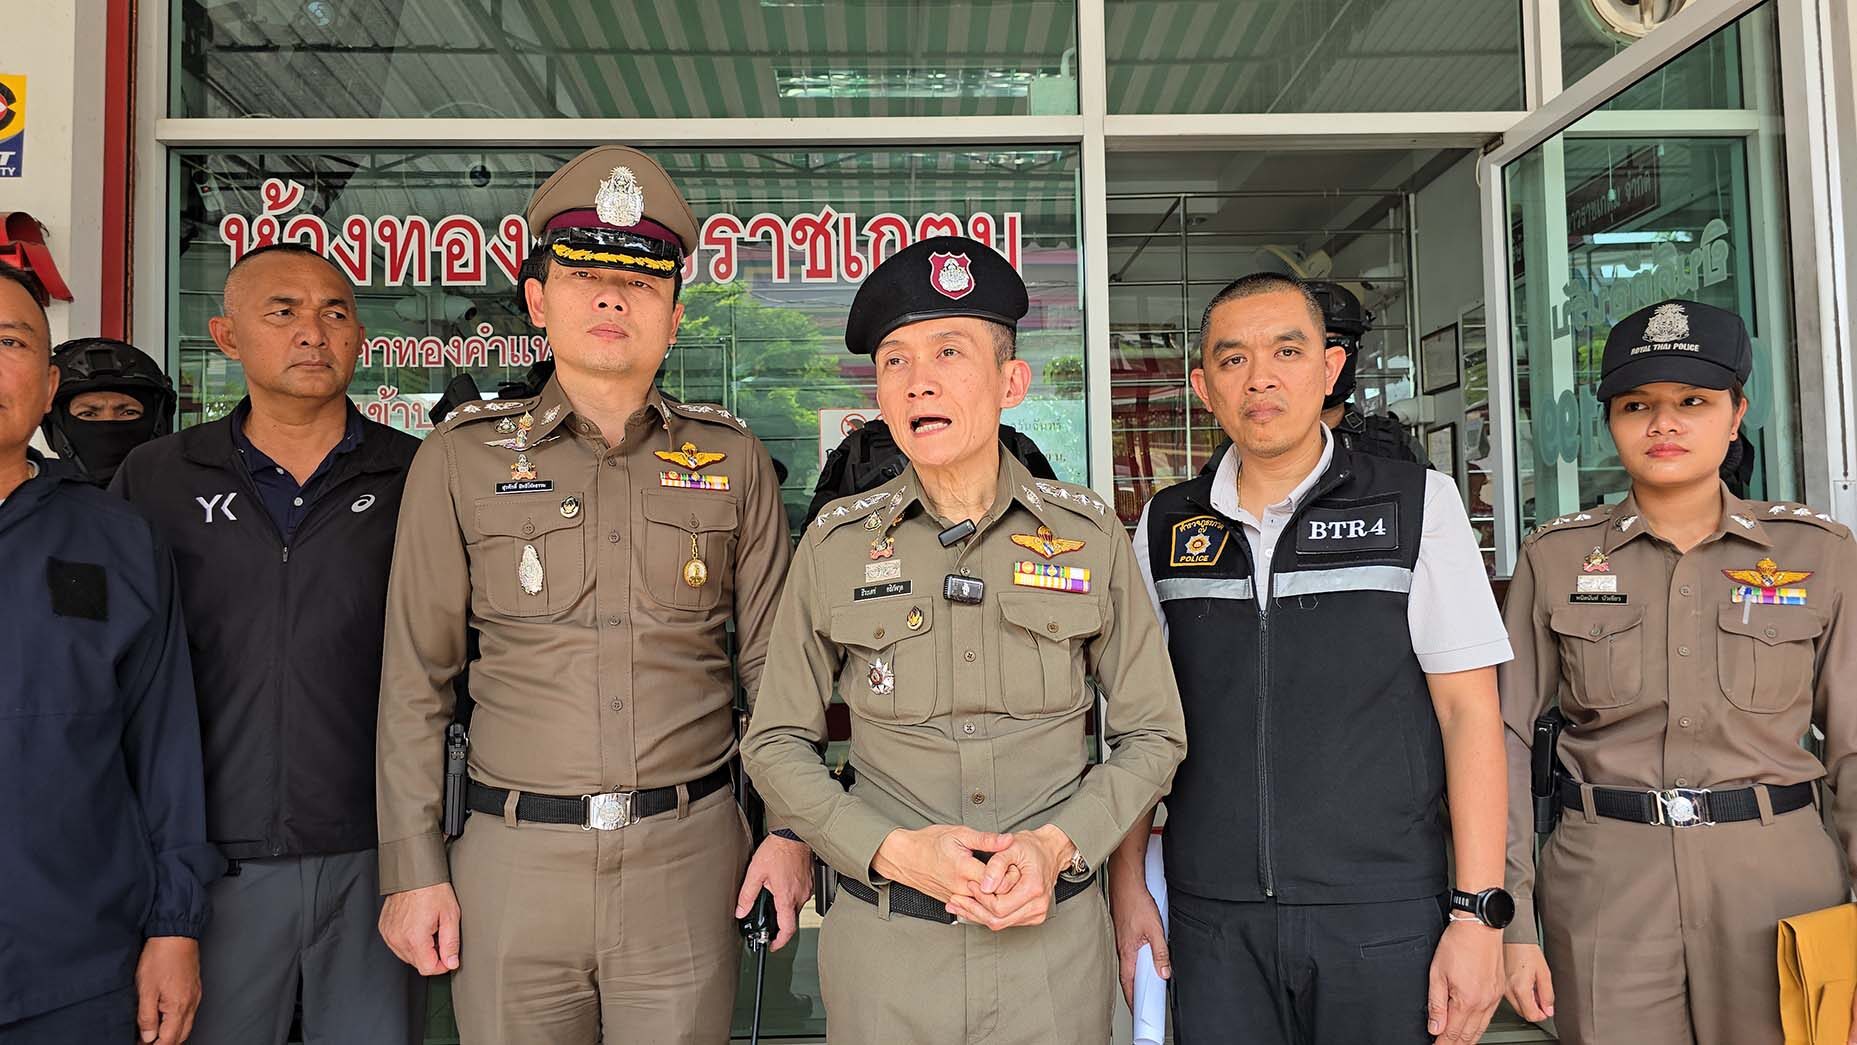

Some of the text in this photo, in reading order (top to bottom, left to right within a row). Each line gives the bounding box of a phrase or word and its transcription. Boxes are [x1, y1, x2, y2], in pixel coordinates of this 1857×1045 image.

[1630, 343, 1700, 355] ROYAL THAI POLICE
[1308, 517, 1387, 540] BTR4
